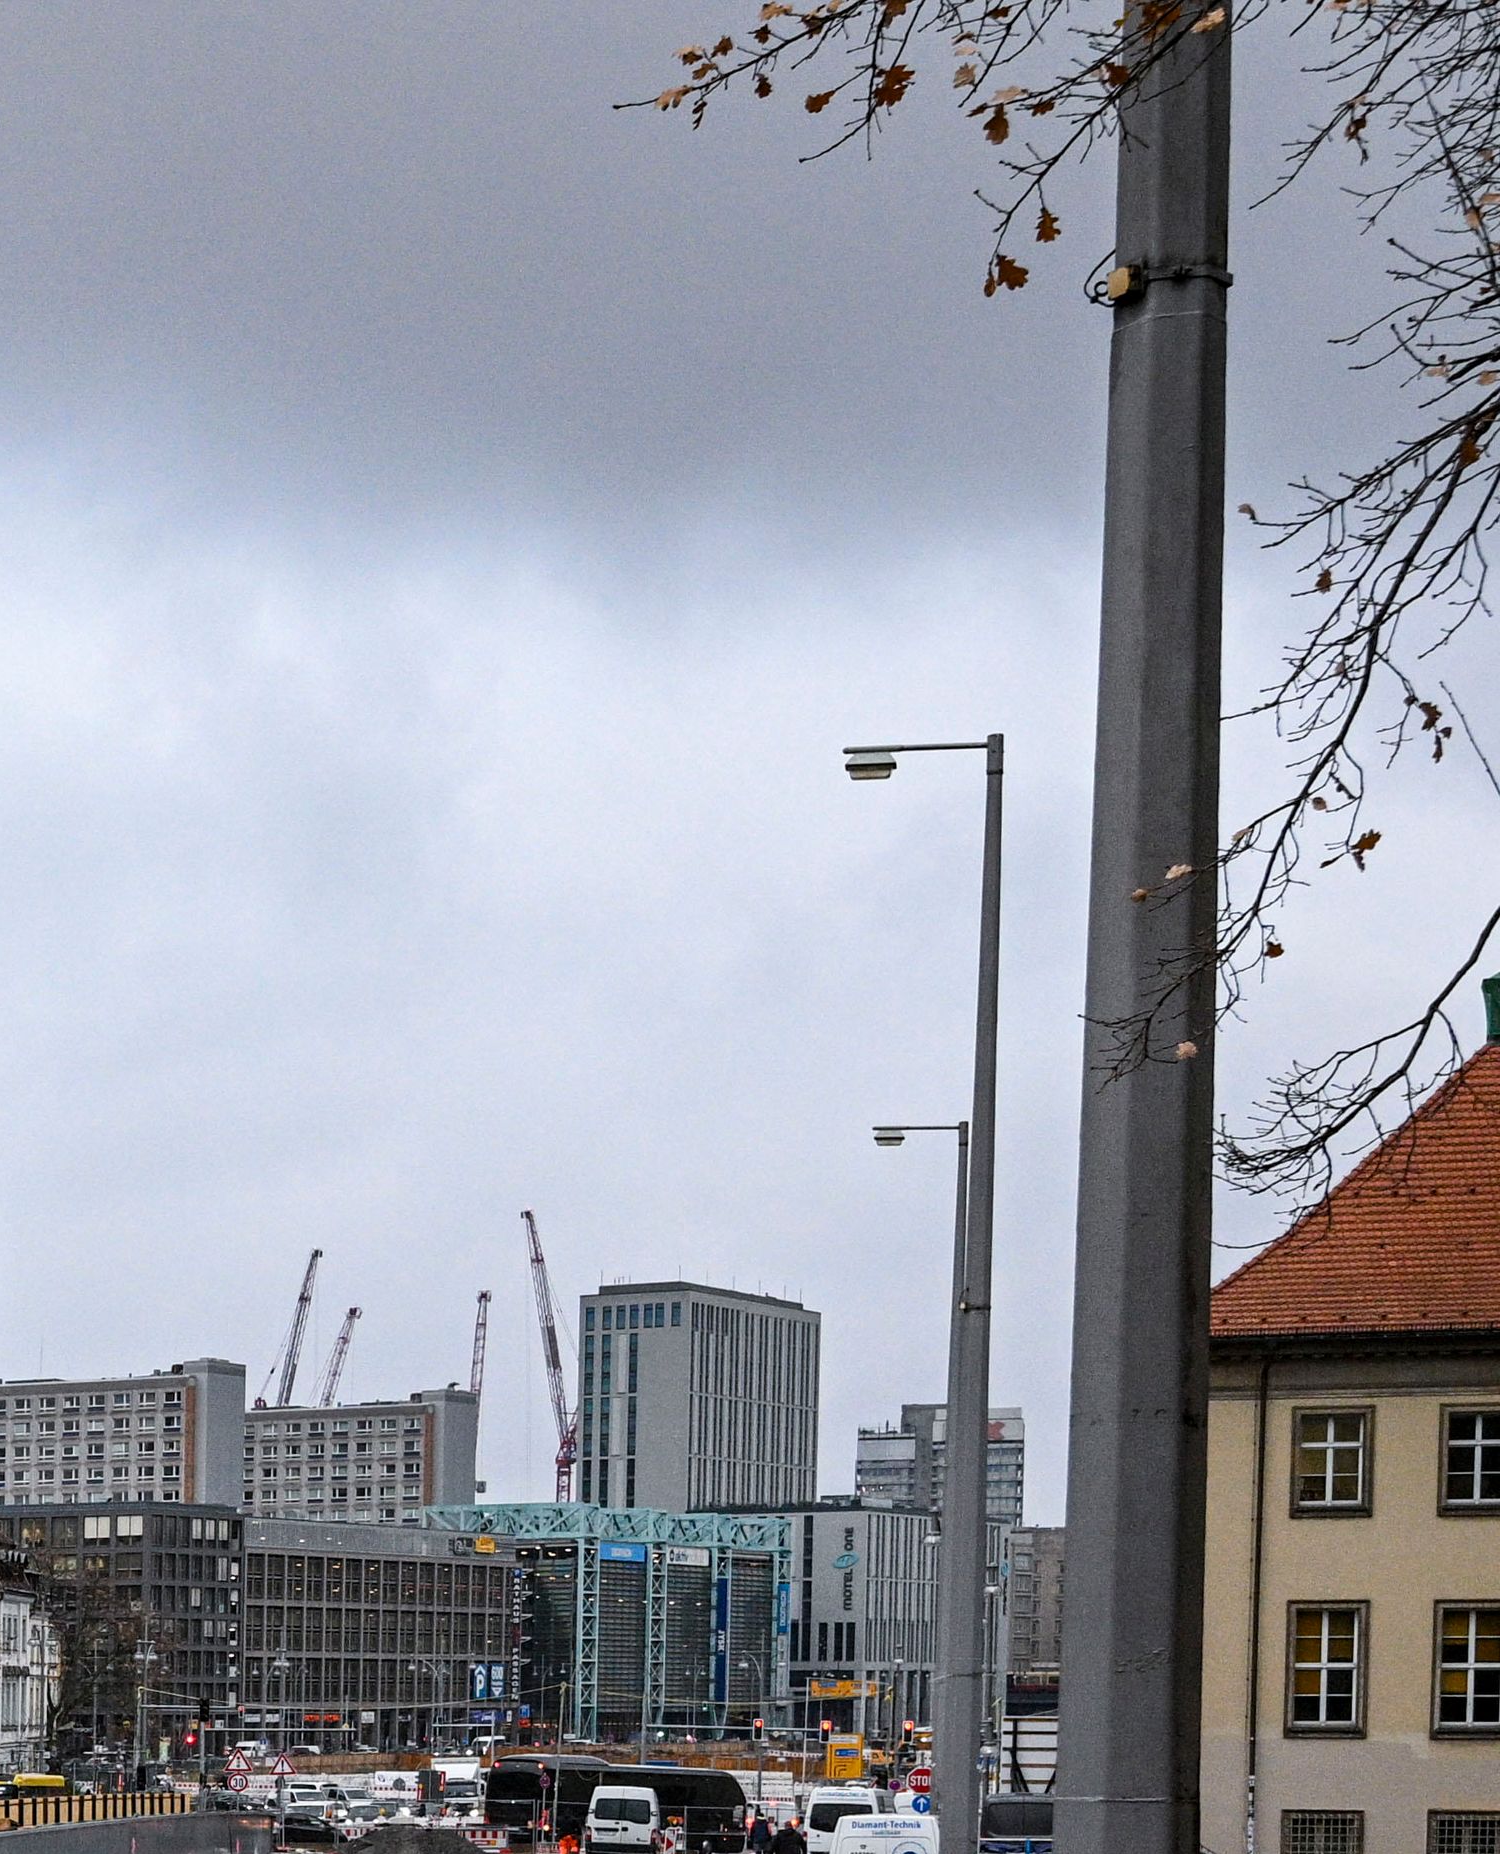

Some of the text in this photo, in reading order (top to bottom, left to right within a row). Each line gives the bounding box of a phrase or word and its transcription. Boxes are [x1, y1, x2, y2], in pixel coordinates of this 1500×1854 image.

[843, 1527, 854, 1611] MOTEL ONE
[511, 1578, 520, 1700] RATHAUS PASSAGEN
[717, 1629, 726, 1653] JYSK
[476, 1673, 485, 1698] P
[233, 1778, 244, 1787] 30
[851, 1821, 921, 1829] Diamant-Technik
